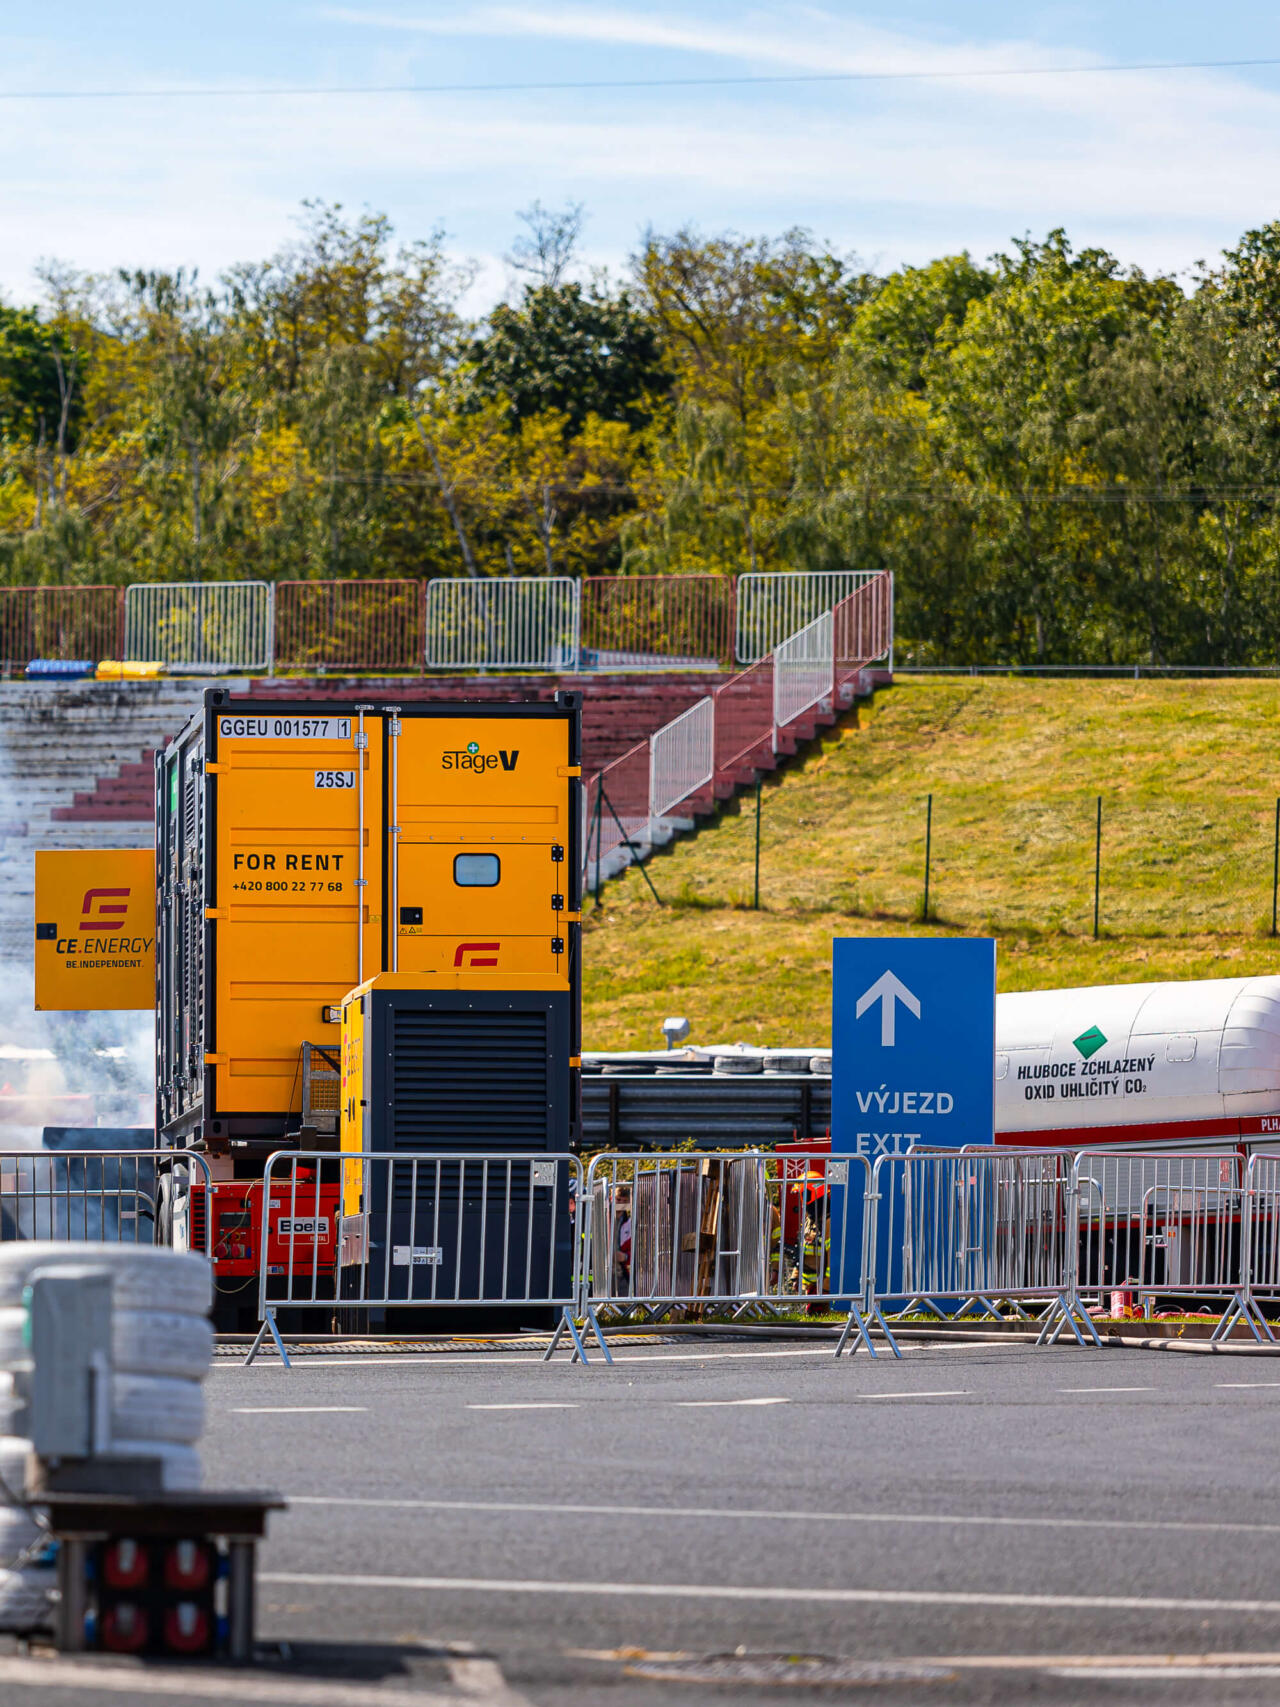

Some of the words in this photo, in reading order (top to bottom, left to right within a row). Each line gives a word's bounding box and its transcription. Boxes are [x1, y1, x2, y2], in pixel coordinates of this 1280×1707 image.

[220, 719, 268, 736] GGEU
[274, 720, 329, 737] 001577
[340, 721, 348, 737] 1
[316, 772, 354, 788] 25SJ
[233, 853, 276, 870] FOR
[286, 854, 344, 871] RENT
[233, 881, 263, 891] +420
[265, 881, 288, 891] 800
[291, 881, 306, 891] 22
[310, 882, 324, 892] 77
[327, 882, 343, 892] 68
[56, 938, 154, 953] CE.ENERGY
[1017, 1062, 1077, 1080] HLUBOCE
[1081, 1053, 1156, 1076] ZCHLAZENÝ
[1025, 1084, 1055, 1100] OXID
[1061, 1076, 1120, 1098] UHLIČITÝ
[856, 1083, 954, 1114] VÝJEZD
[1261, 1118, 1280, 1131] PLH
[856, 1133, 921, 1155] EXIT
[280, 1219, 327, 1232] Boels
